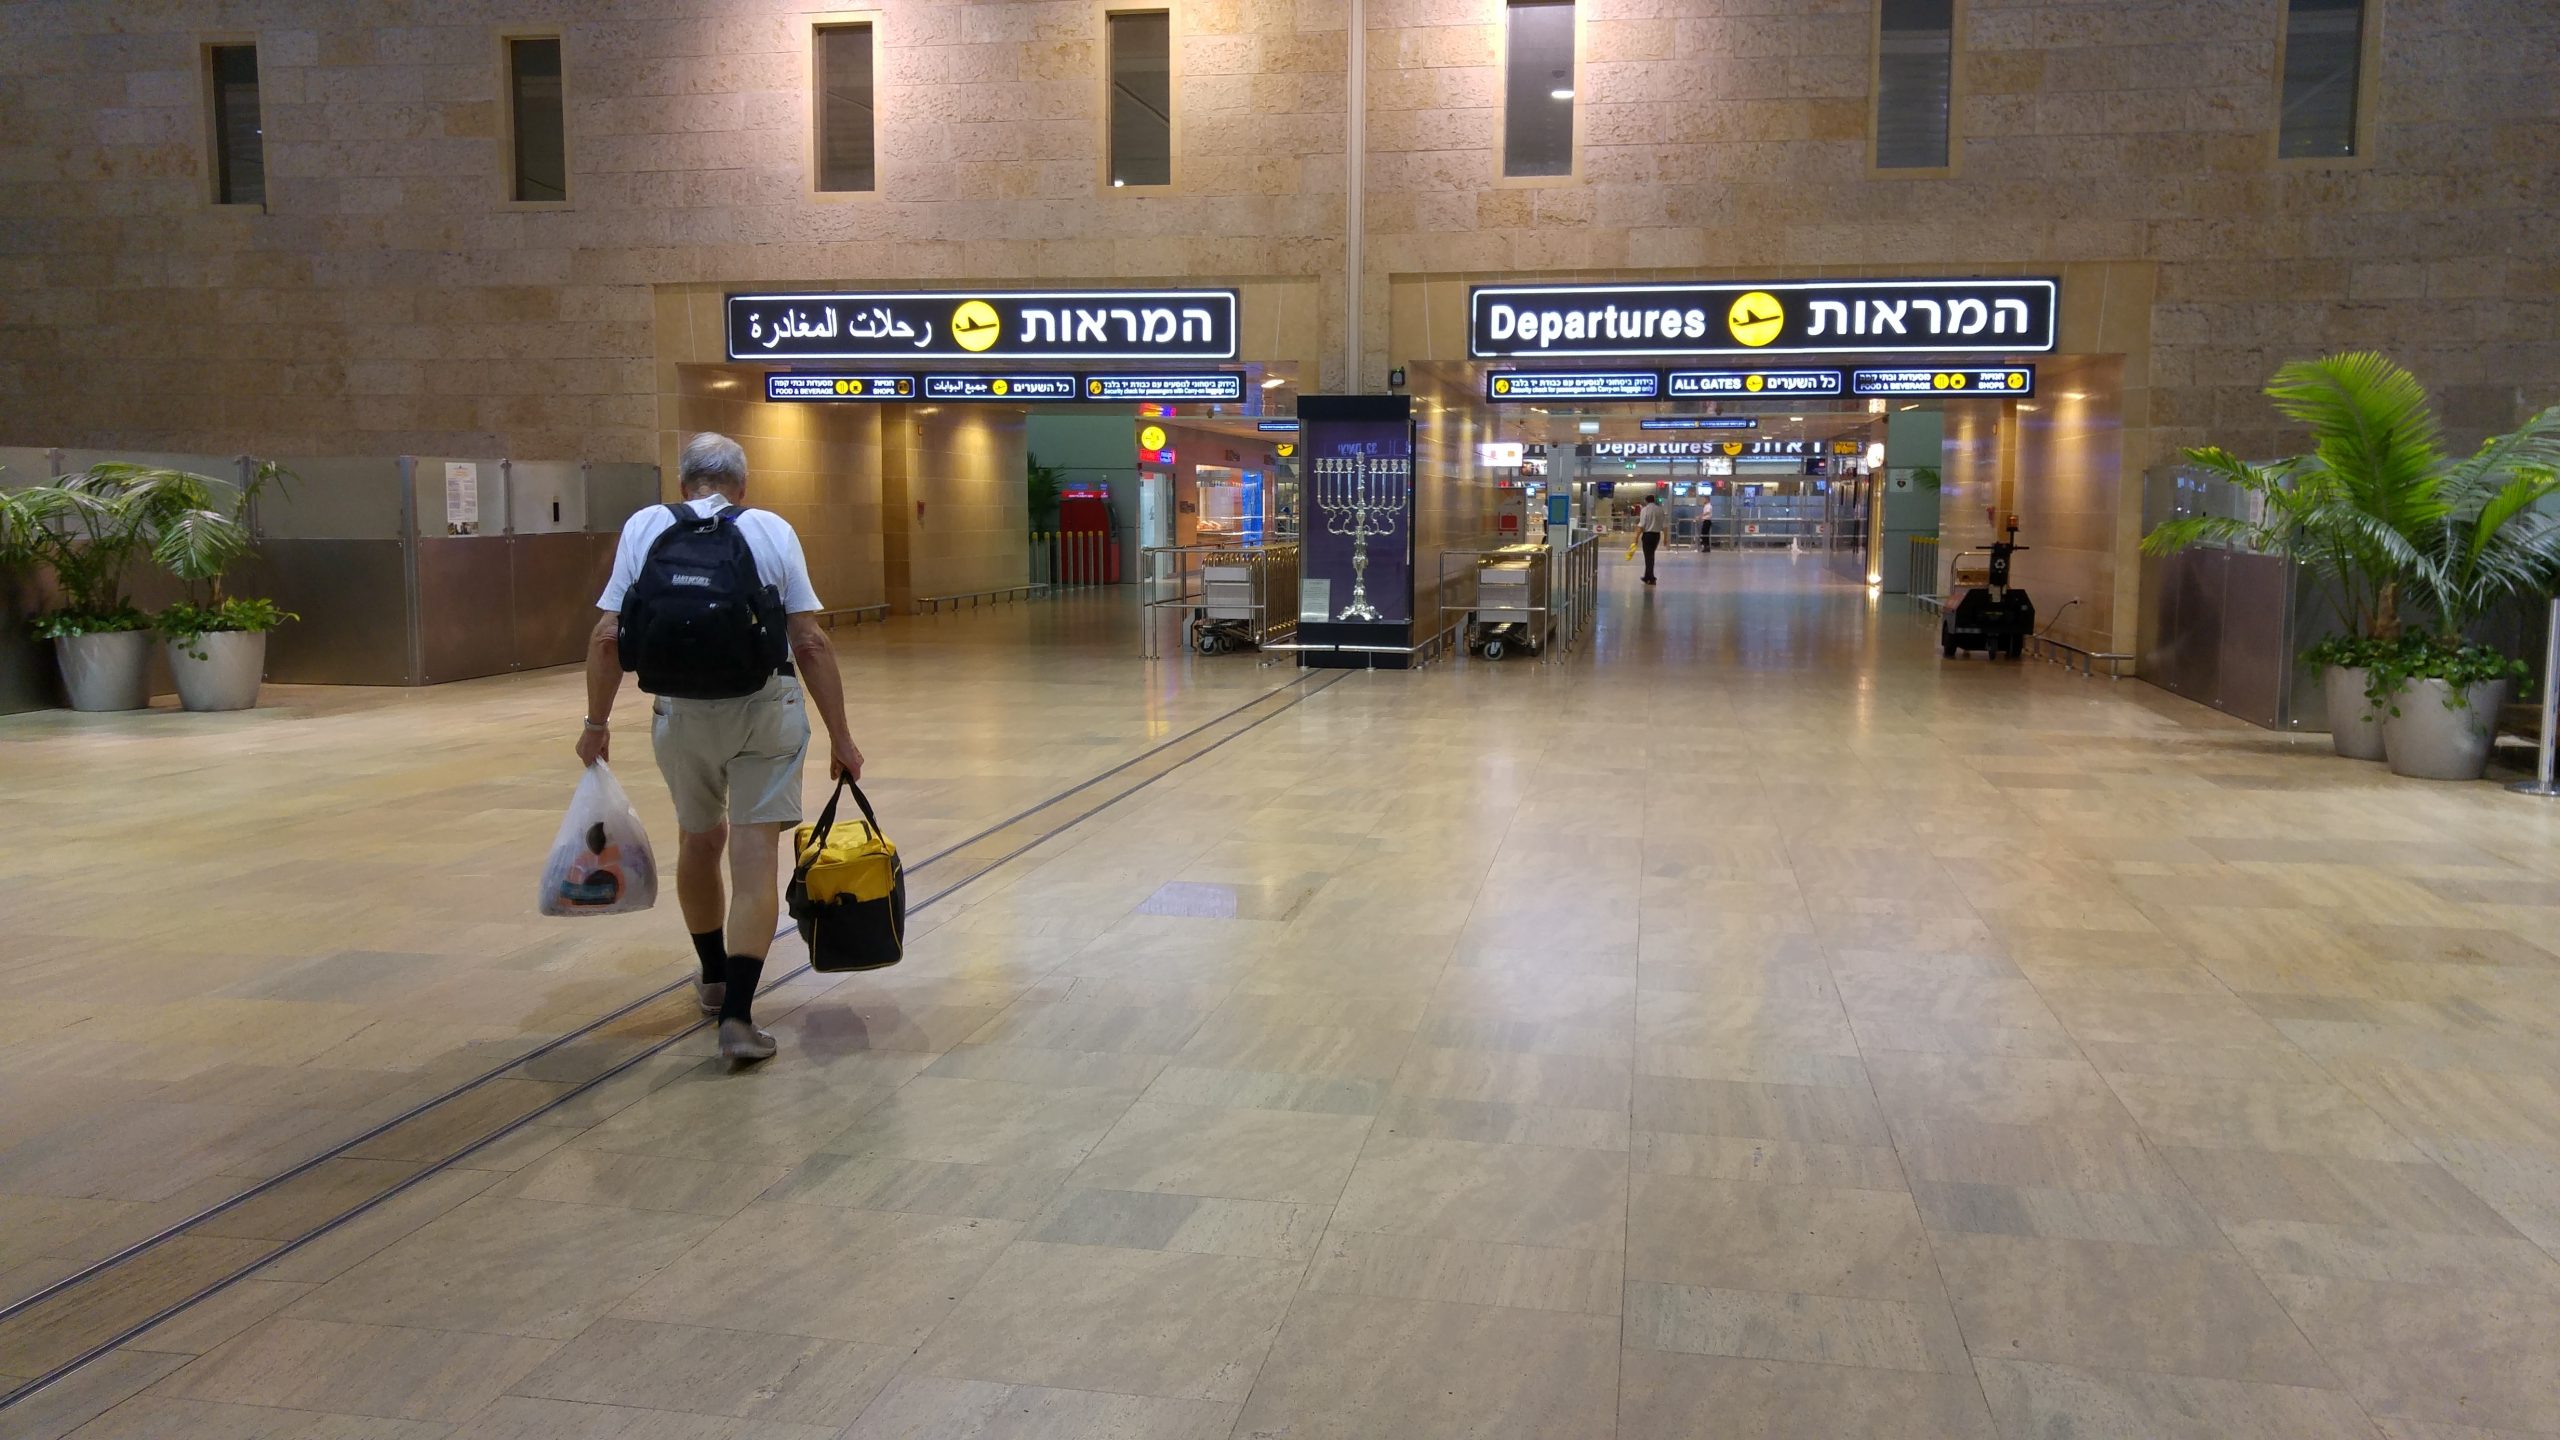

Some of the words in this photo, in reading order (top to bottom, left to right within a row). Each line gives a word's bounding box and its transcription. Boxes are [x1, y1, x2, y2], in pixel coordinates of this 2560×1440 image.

[1807, 298, 2028, 335] המראות
[750, 306, 838, 348] المغادرة
[848, 306, 933, 348] رحلات
[1020, 308, 1212, 342] המראות
[1490, 304, 1706, 348] Departures
[933, 380, 963, 393] البوابات
[965, 381, 988, 394] جميع
[1013, 383, 1054, 393] השערים
[1056, 381, 1070, 392] כל
[1674, 378, 1699, 390] ALL
[1700, 377, 1742, 389] GATES
[1767, 377, 1817, 389] השערים
[1820, 375, 1836, 388] כל
[1642, 385, 1653, 393] only
[1595, 442, 1713, 456] Departures
